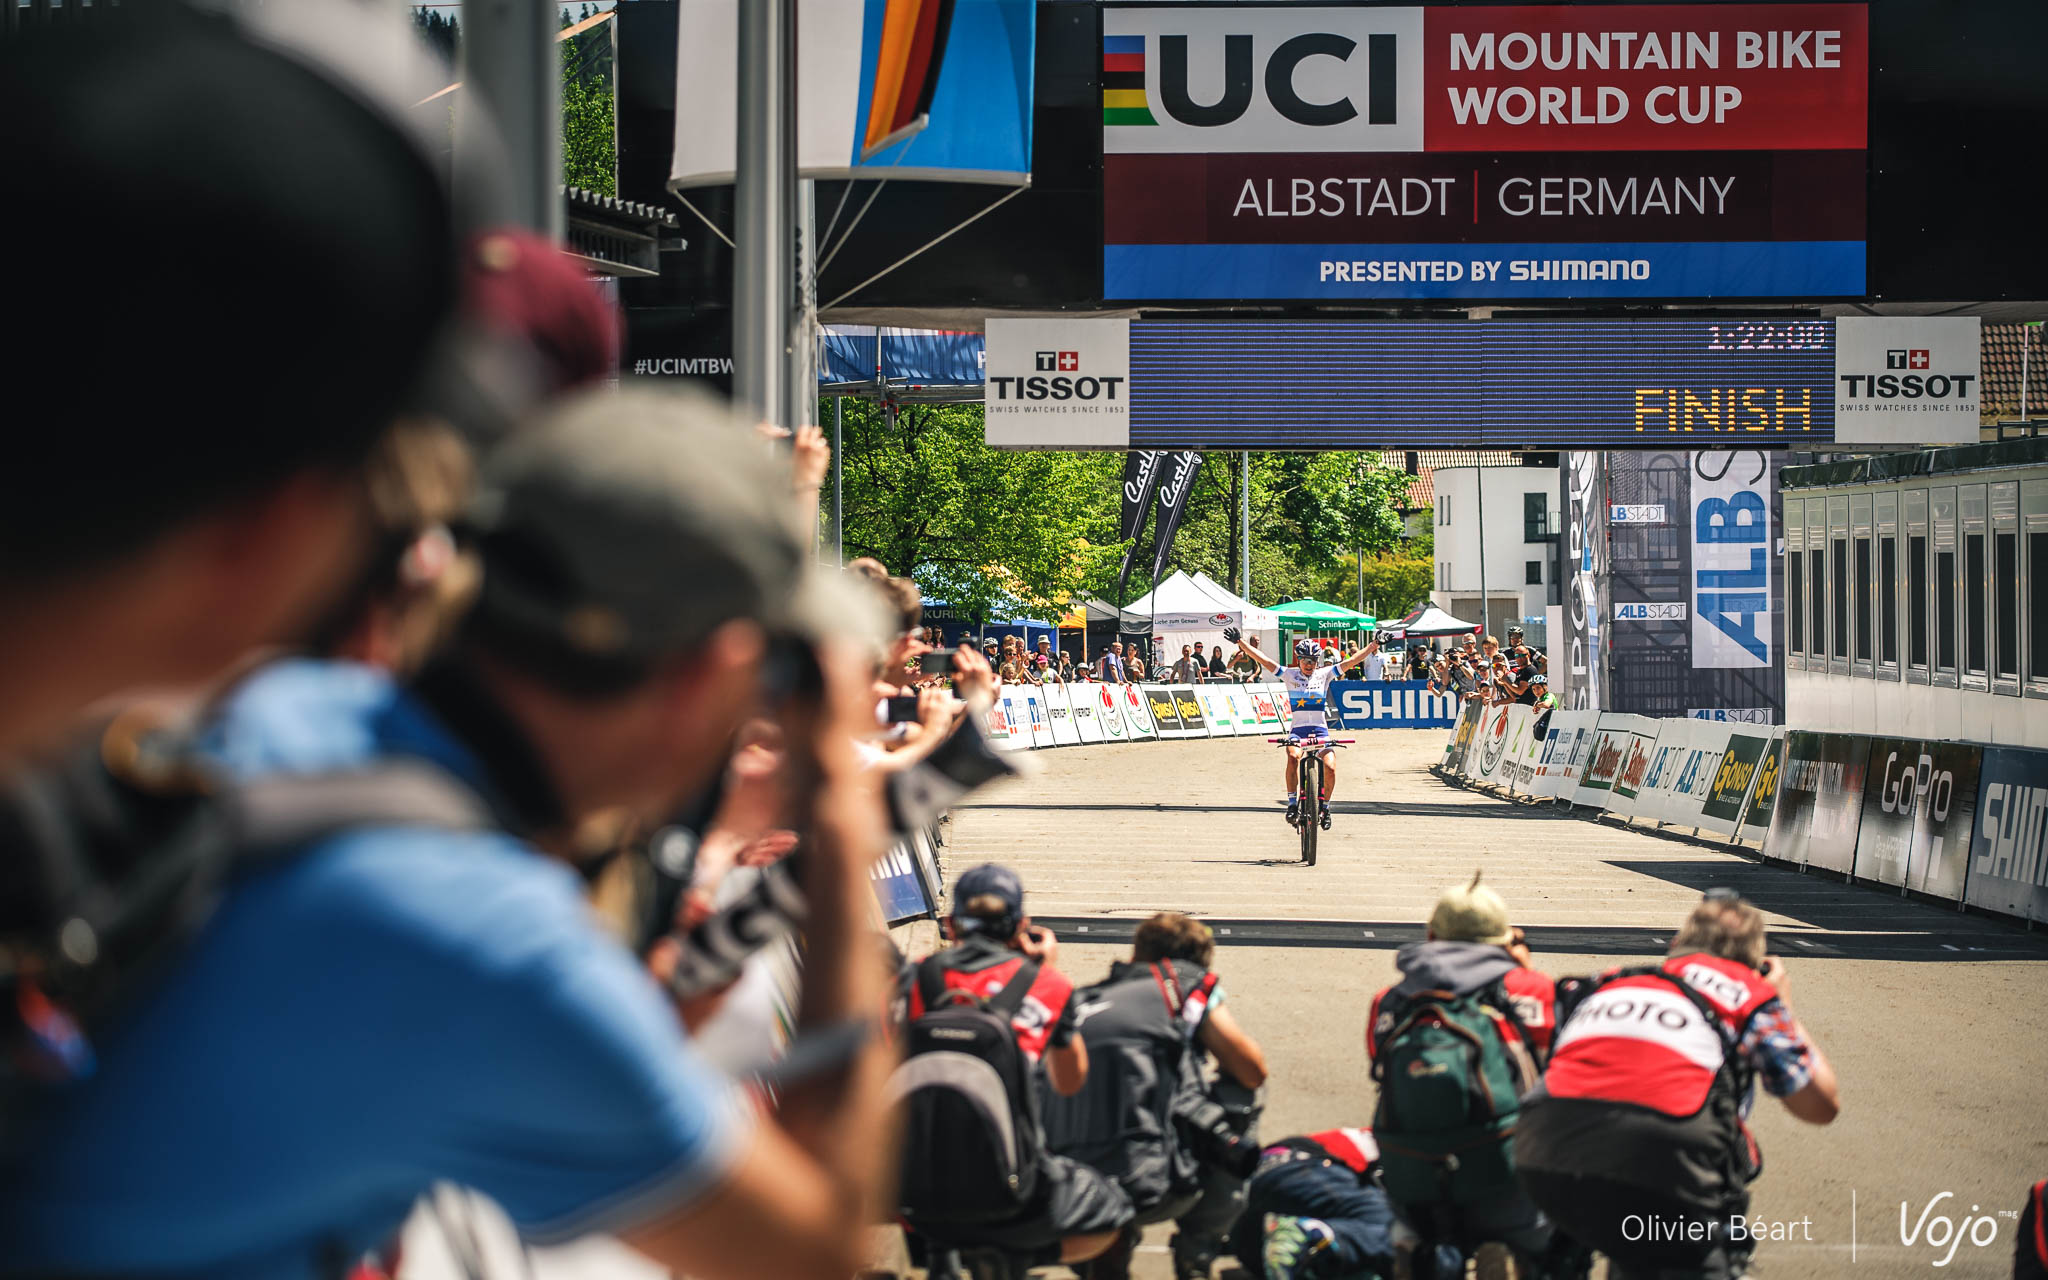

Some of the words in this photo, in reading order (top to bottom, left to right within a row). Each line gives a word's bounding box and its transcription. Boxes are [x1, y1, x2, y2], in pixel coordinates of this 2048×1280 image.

[1449, 32, 1720, 71] MOUNTAIN
[1736, 29, 1842, 70] BIKE
[1159, 33, 1398, 127] UCI
[1448, 87, 1630, 126] WORLD
[1644, 85, 1743, 125] CUP
[1232, 178, 1456, 218] ALBSTADT
[1497, 176, 1736, 217] GERMANY
[1319, 260, 1465, 283] PRESENTED
[1470, 260, 1502, 283] BY
[1508, 259, 1650, 282] SHIMANO
[990, 376, 1124, 400] TISSOT
[1841, 374, 1975, 398] TISSOT
[990, 405, 1021, 414] SWISS
[1024, 405, 1068, 414] WATCHES
[1072, 405, 1100, 414] SINCE
[1104, 405, 1125, 414] 1853
[1635, 389, 1811, 432] FINISH
[1840, 404, 1870, 412] SWISS
[1874, 404, 1918, 412] WATCHES
[1922, 404, 1951, 412] SINCE
[1955, 404, 1976, 412] 1853
[1318, 620, 1351, 629] Schinken
[1617, 604, 1687, 619] ALBSTADT
[1881, 751, 1953, 822] GoPro
[1976, 782, 2048, 888] SHIM
